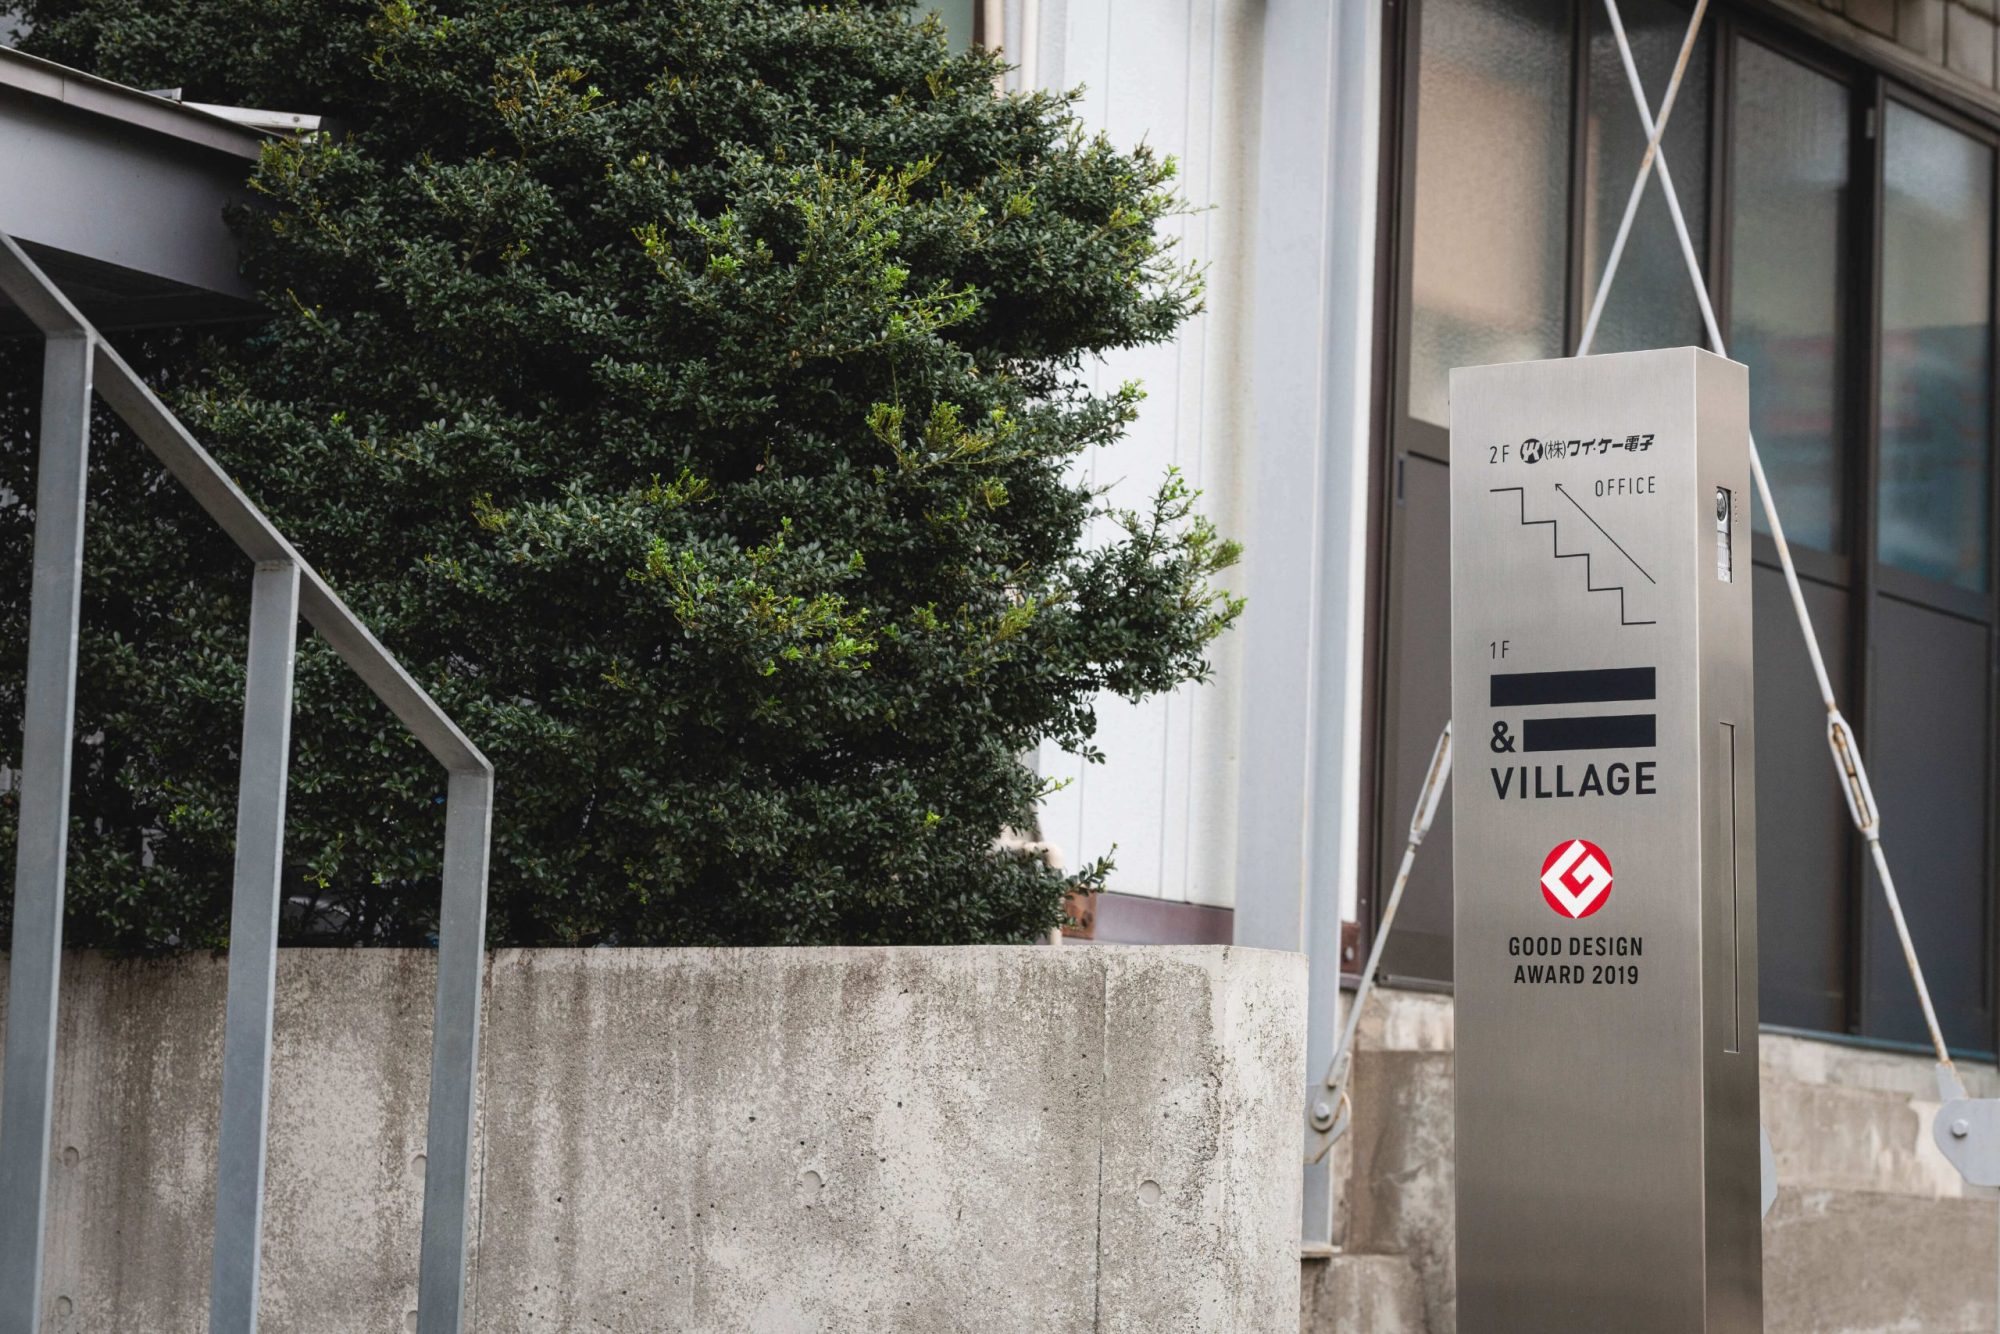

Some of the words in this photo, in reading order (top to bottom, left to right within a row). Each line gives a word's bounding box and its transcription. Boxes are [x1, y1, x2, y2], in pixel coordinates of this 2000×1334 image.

[1489, 444, 1510, 464] 2F
[1595, 476, 1656, 497] OFFICE
[1490, 640, 1510, 659] 1F
[1490, 720, 1517, 754] &
[1490, 762, 1657, 800] VILLAGE
[1508, 936, 1562, 957] GOOD
[1569, 936, 1643, 957] DESIGN
[1513, 964, 1585, 985] AWARD
[1592, 965, 1639, 985] 2019
